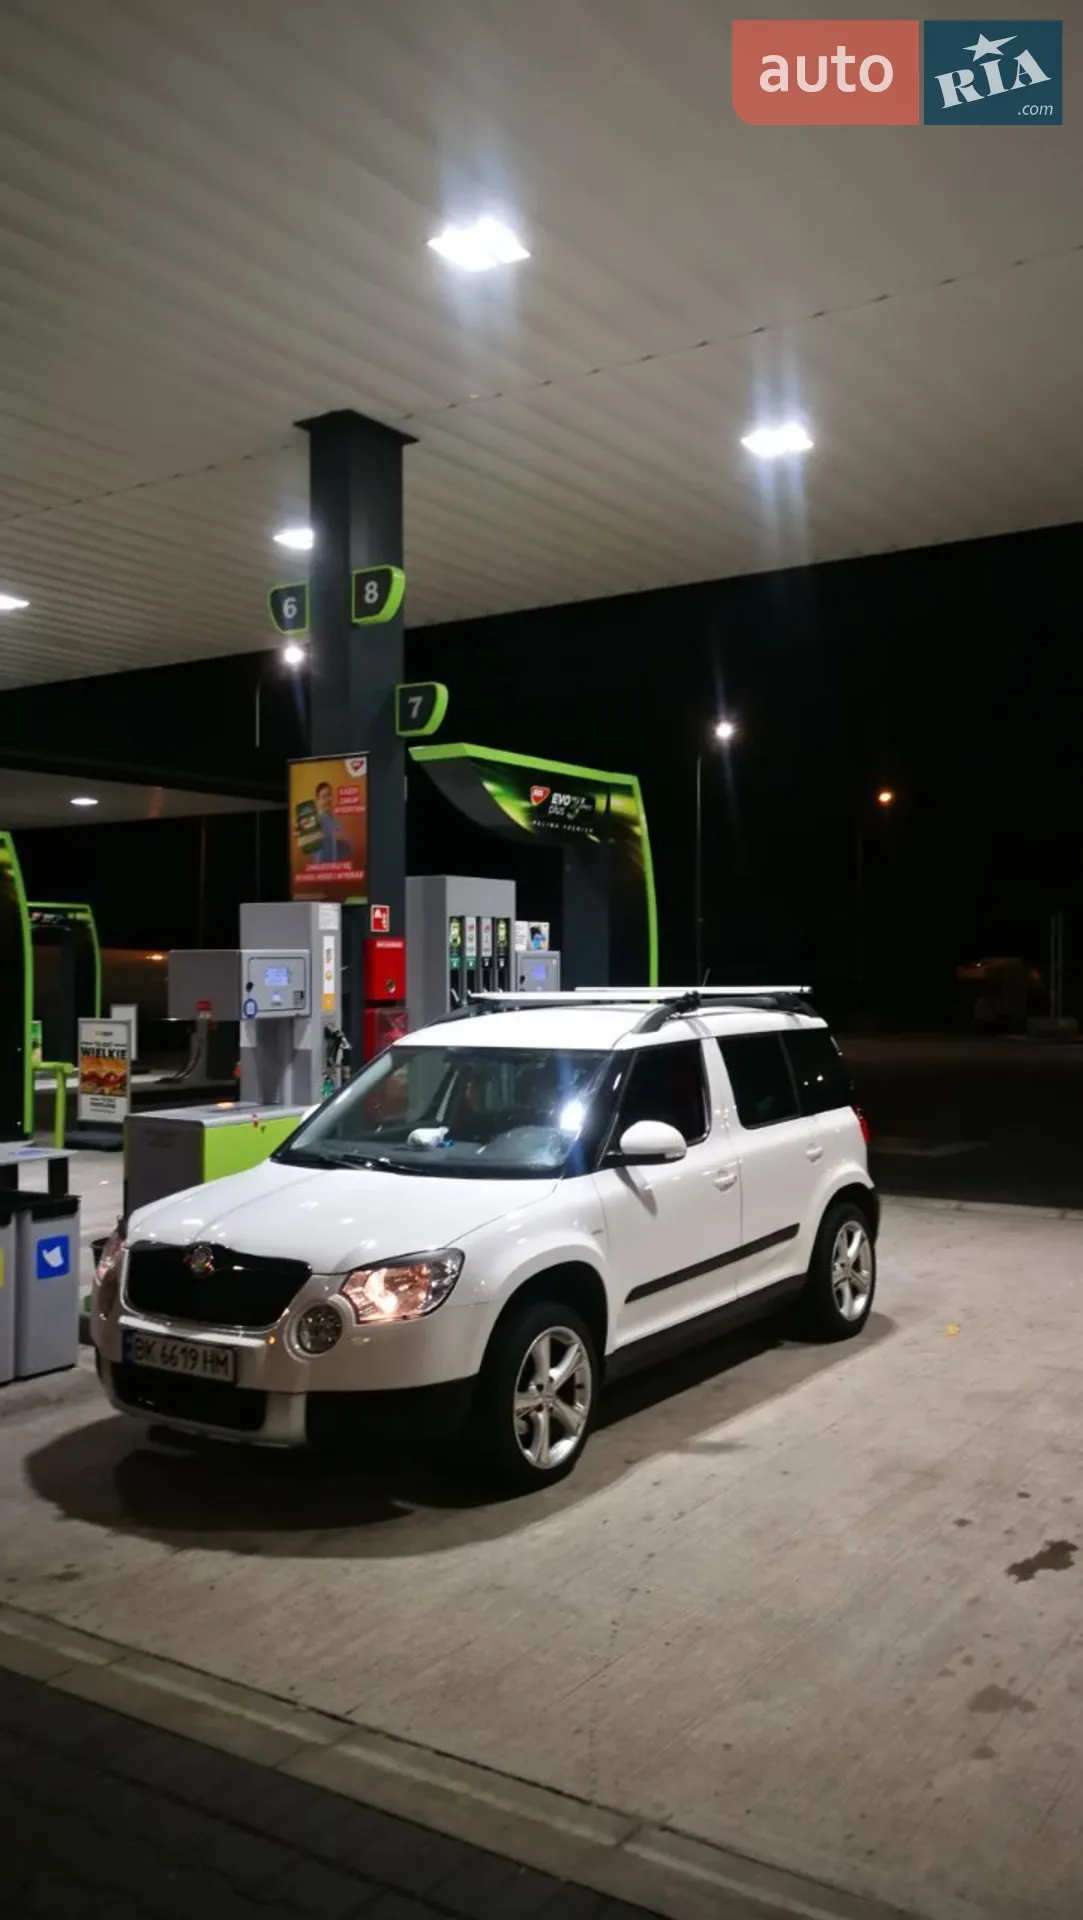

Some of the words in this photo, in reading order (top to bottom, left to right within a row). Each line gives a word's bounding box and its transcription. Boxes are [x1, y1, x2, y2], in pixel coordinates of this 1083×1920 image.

[364, 580, 379, 604] 8
[282, 597, 297, 619] 6
[408, 696, 423, 719] 7
[551, 792, 571, 806] EVO
[80, 1046, 128, 1060] WIELKIE
[135, 1337, 156, 1361] BK
[160, 1341, 200, 1372] 6619
[202, 1349, 230, 1377] HM
